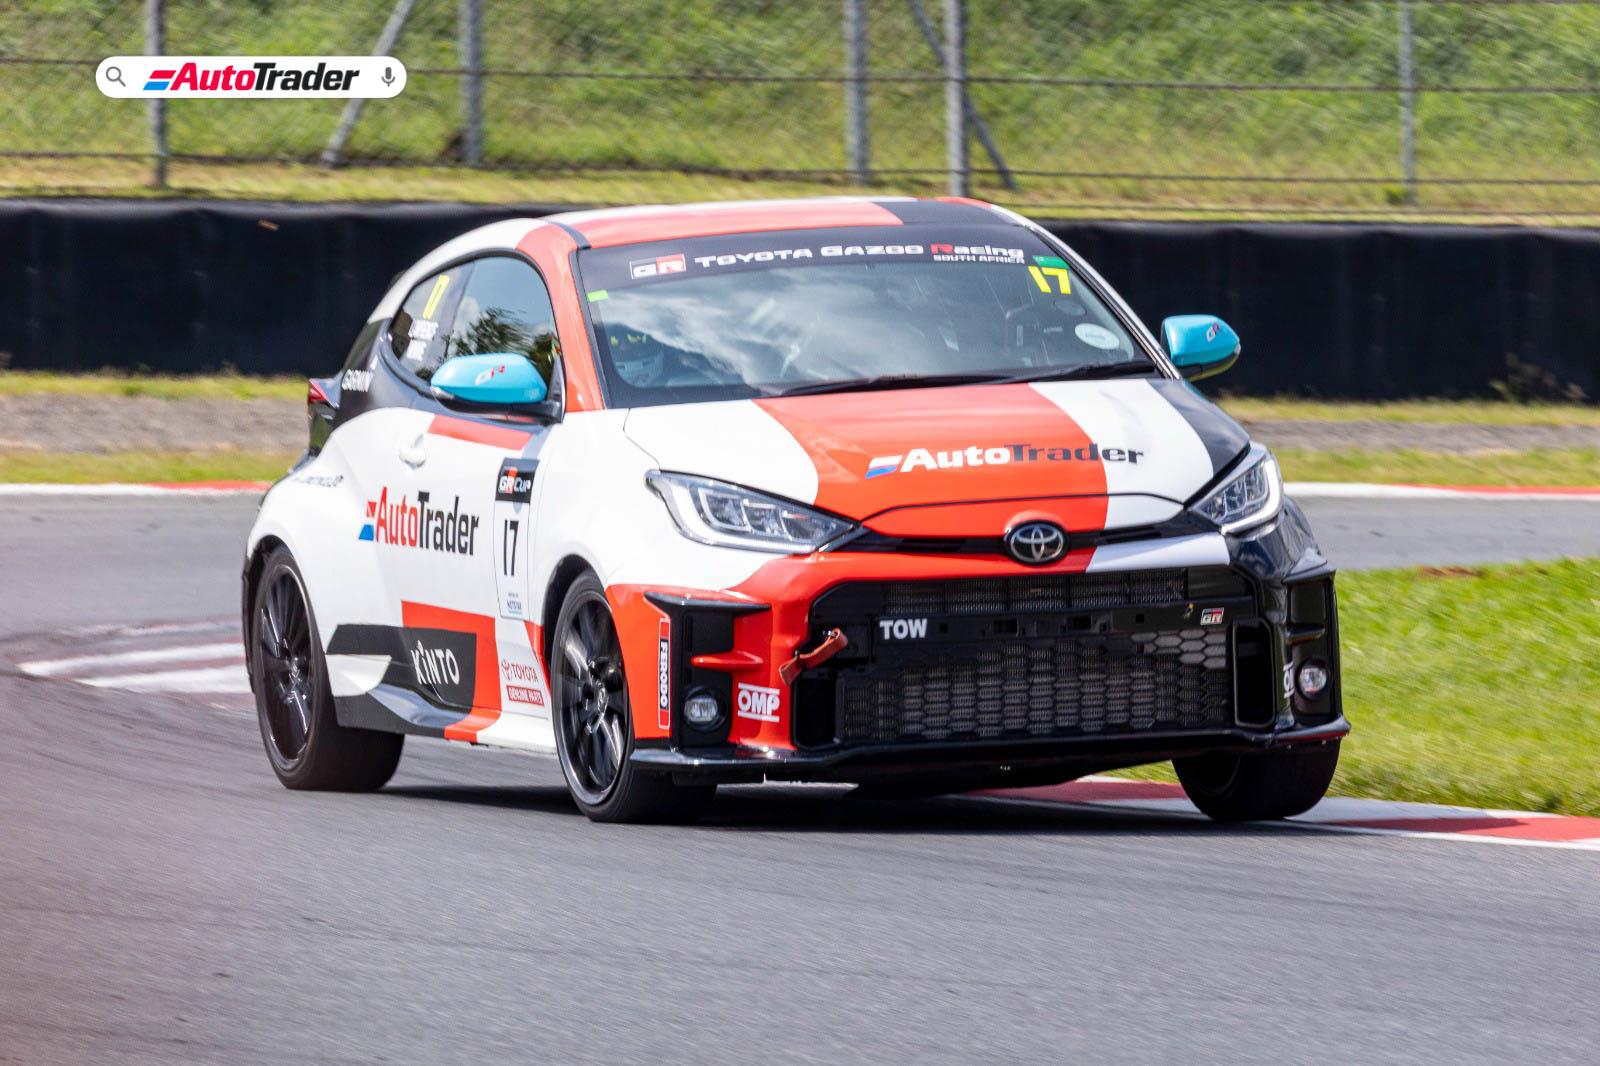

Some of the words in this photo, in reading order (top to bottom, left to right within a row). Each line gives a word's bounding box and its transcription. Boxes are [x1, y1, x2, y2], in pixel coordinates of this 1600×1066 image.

[694, 247, 813, 268] TOYOTA
[820, 244, 924, 257] GAZOO
[929, 243, 1025, 260] Racing
[933, 254, 977, 262] SOUTH
[978, 255, 1025, 265] AFRICA
[1028, 265, 1072, 295] 17
[900, 442, 1144, 473] AutoTrader
[375, 486, 480, 556] AutoTrader
[502, 518, 520, 577] 17
[879, 618, 928, 640] TOW
[1200, 610, 1224, 625] GR
[511, 663, 539, 682] TOYOTA
[660, 641, 669, 708] FERODO
[737, 688, 780, 717] OMP
